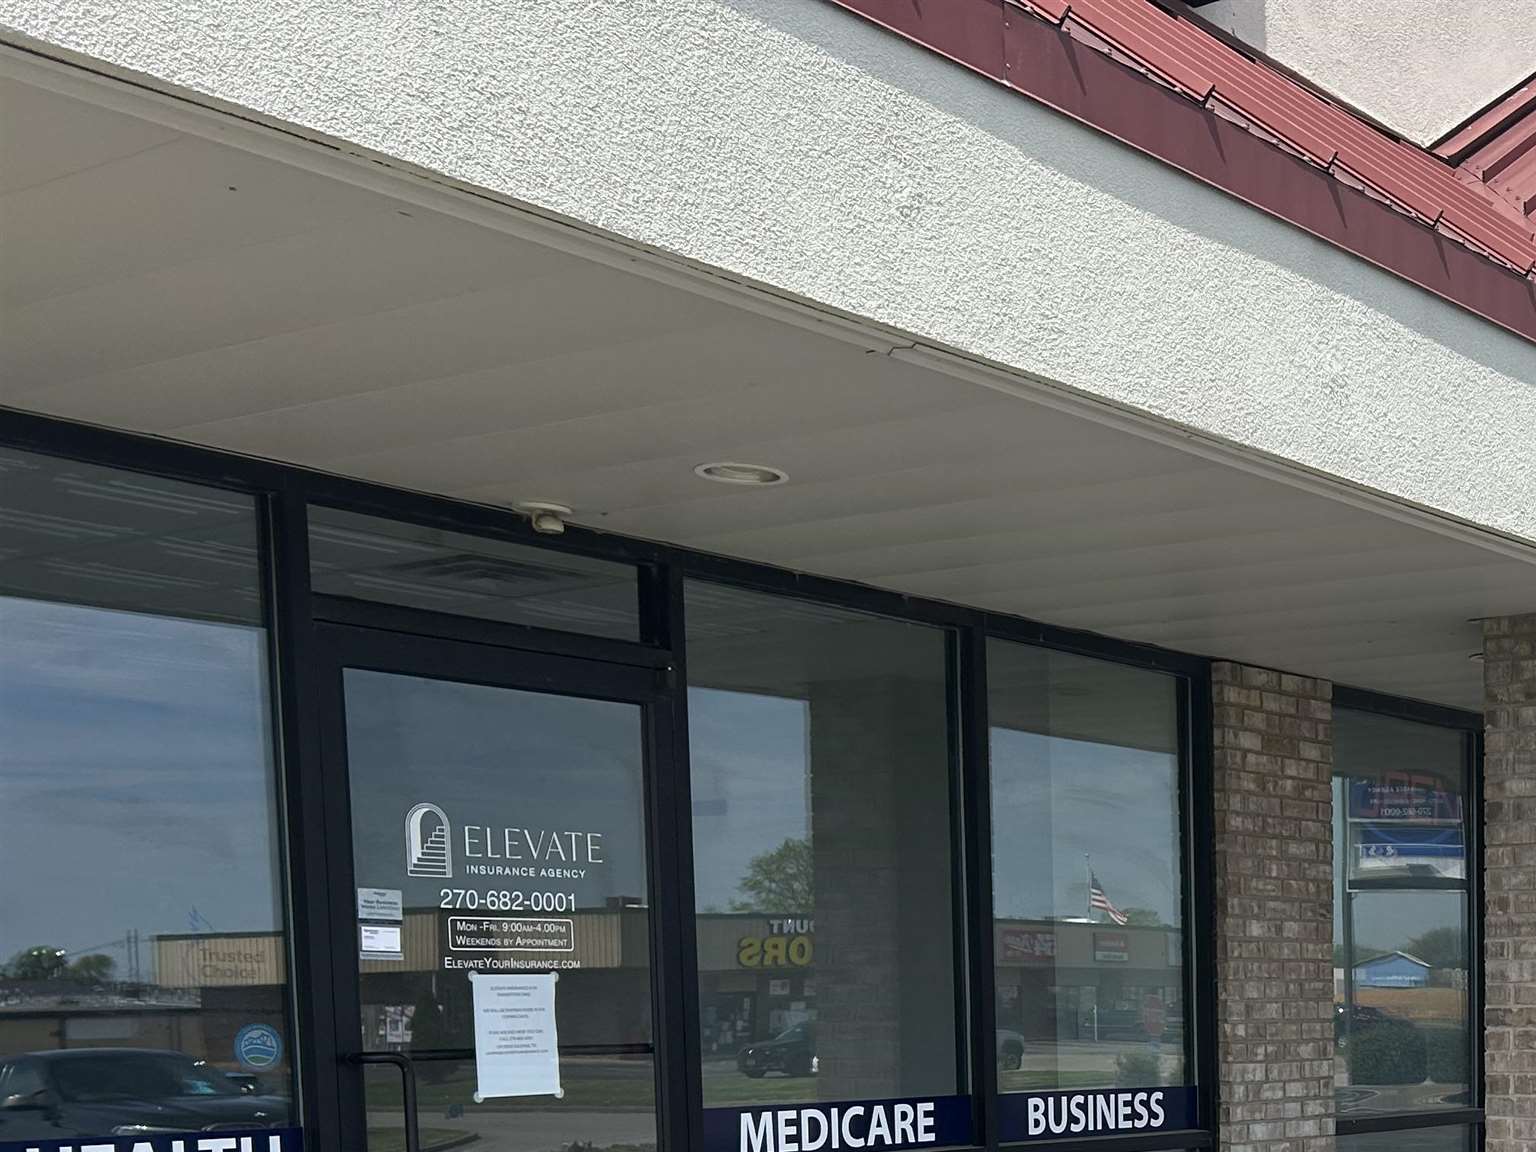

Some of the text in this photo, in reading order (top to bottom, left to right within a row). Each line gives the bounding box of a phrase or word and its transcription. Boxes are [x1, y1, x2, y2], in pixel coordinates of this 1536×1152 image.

[464, 825, 604, 864] ELEVATE
[466, 864, 586, 879] INSURANCE AGENCY
[439, 888, 576, 912] 270-682-0001
[200, 948, 265, 964] Trusted
[1026, 1090, 1165, 1136] BUSINESS
